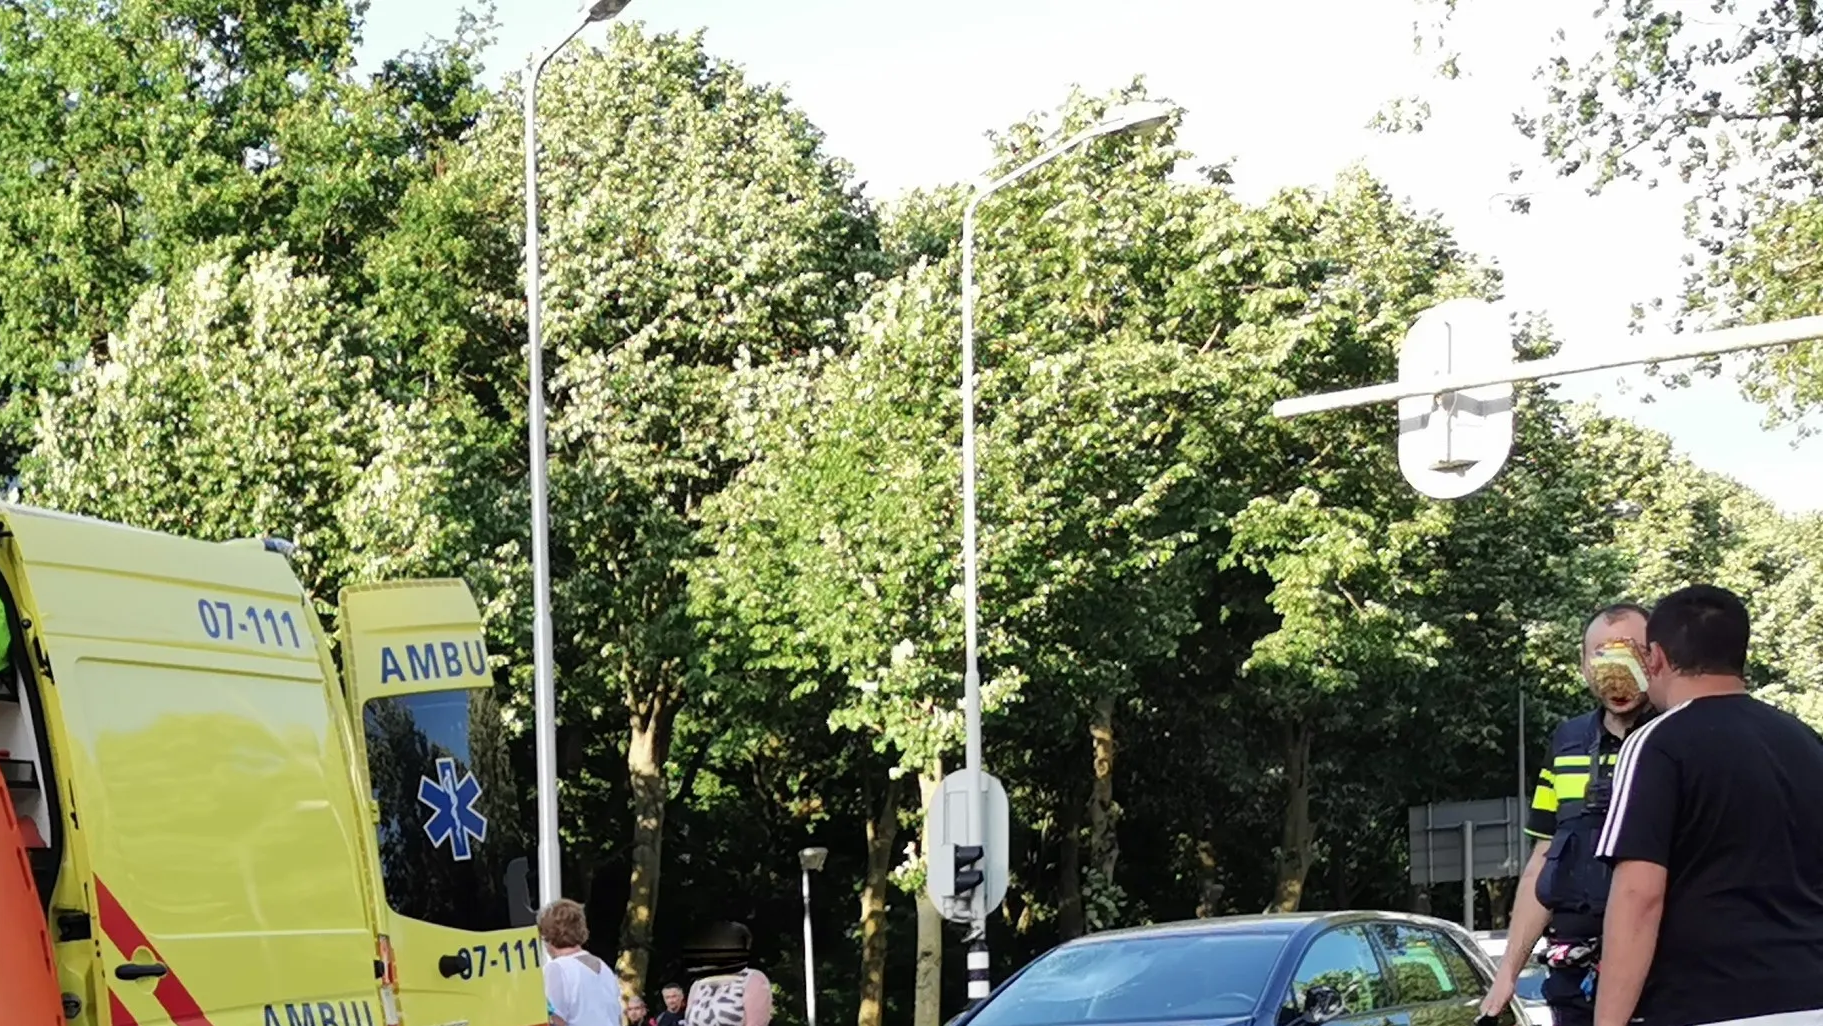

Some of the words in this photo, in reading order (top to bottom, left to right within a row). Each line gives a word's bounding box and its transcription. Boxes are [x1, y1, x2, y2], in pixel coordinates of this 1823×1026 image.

[198, 599, 300, 649] 07-111
[381, 639, 486, 684] AMBU
[457, 938, 540, 980] 07-111
